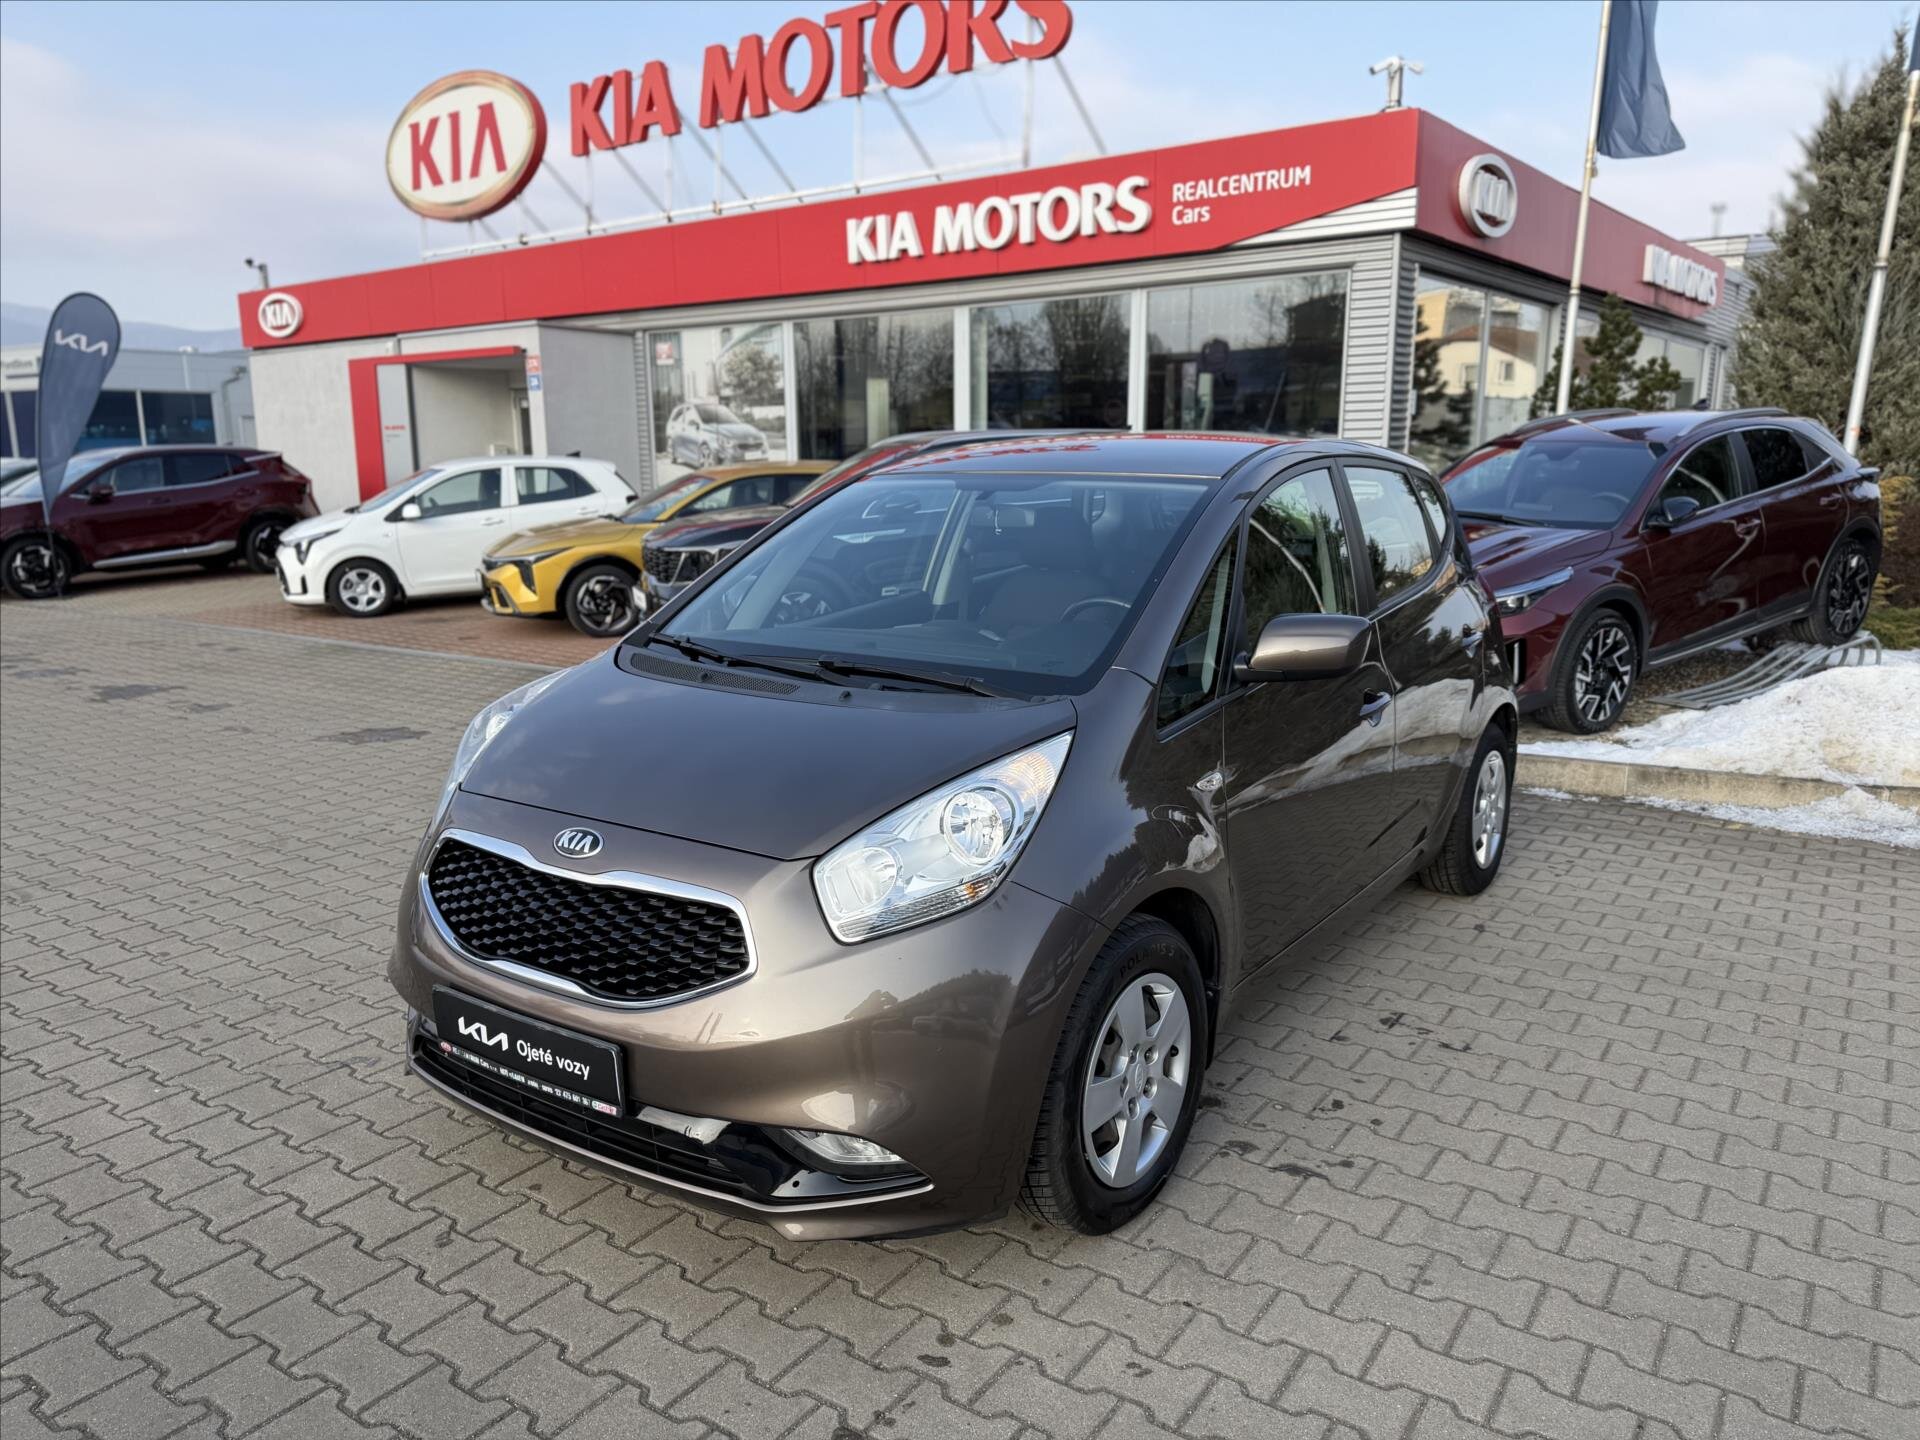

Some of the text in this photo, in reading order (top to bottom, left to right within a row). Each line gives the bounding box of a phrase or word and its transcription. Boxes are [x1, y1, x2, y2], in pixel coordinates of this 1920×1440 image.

[570, 0, 1073, 157] KIA MOTORS
[409, 102, 508, 192] KIA
[1172, 165, 1312, 203] REALCENTRUM
[846, 175, 1152, 265] KIA MOTORS
[1171, 204, 1211, 226] Cars
[264, 302, 293, 328] KIA
[557, 830, 594, 853] KIA
[516, 1039, 553, 1066] Ojeté
[556, 1055, 590, 1080] vozy
